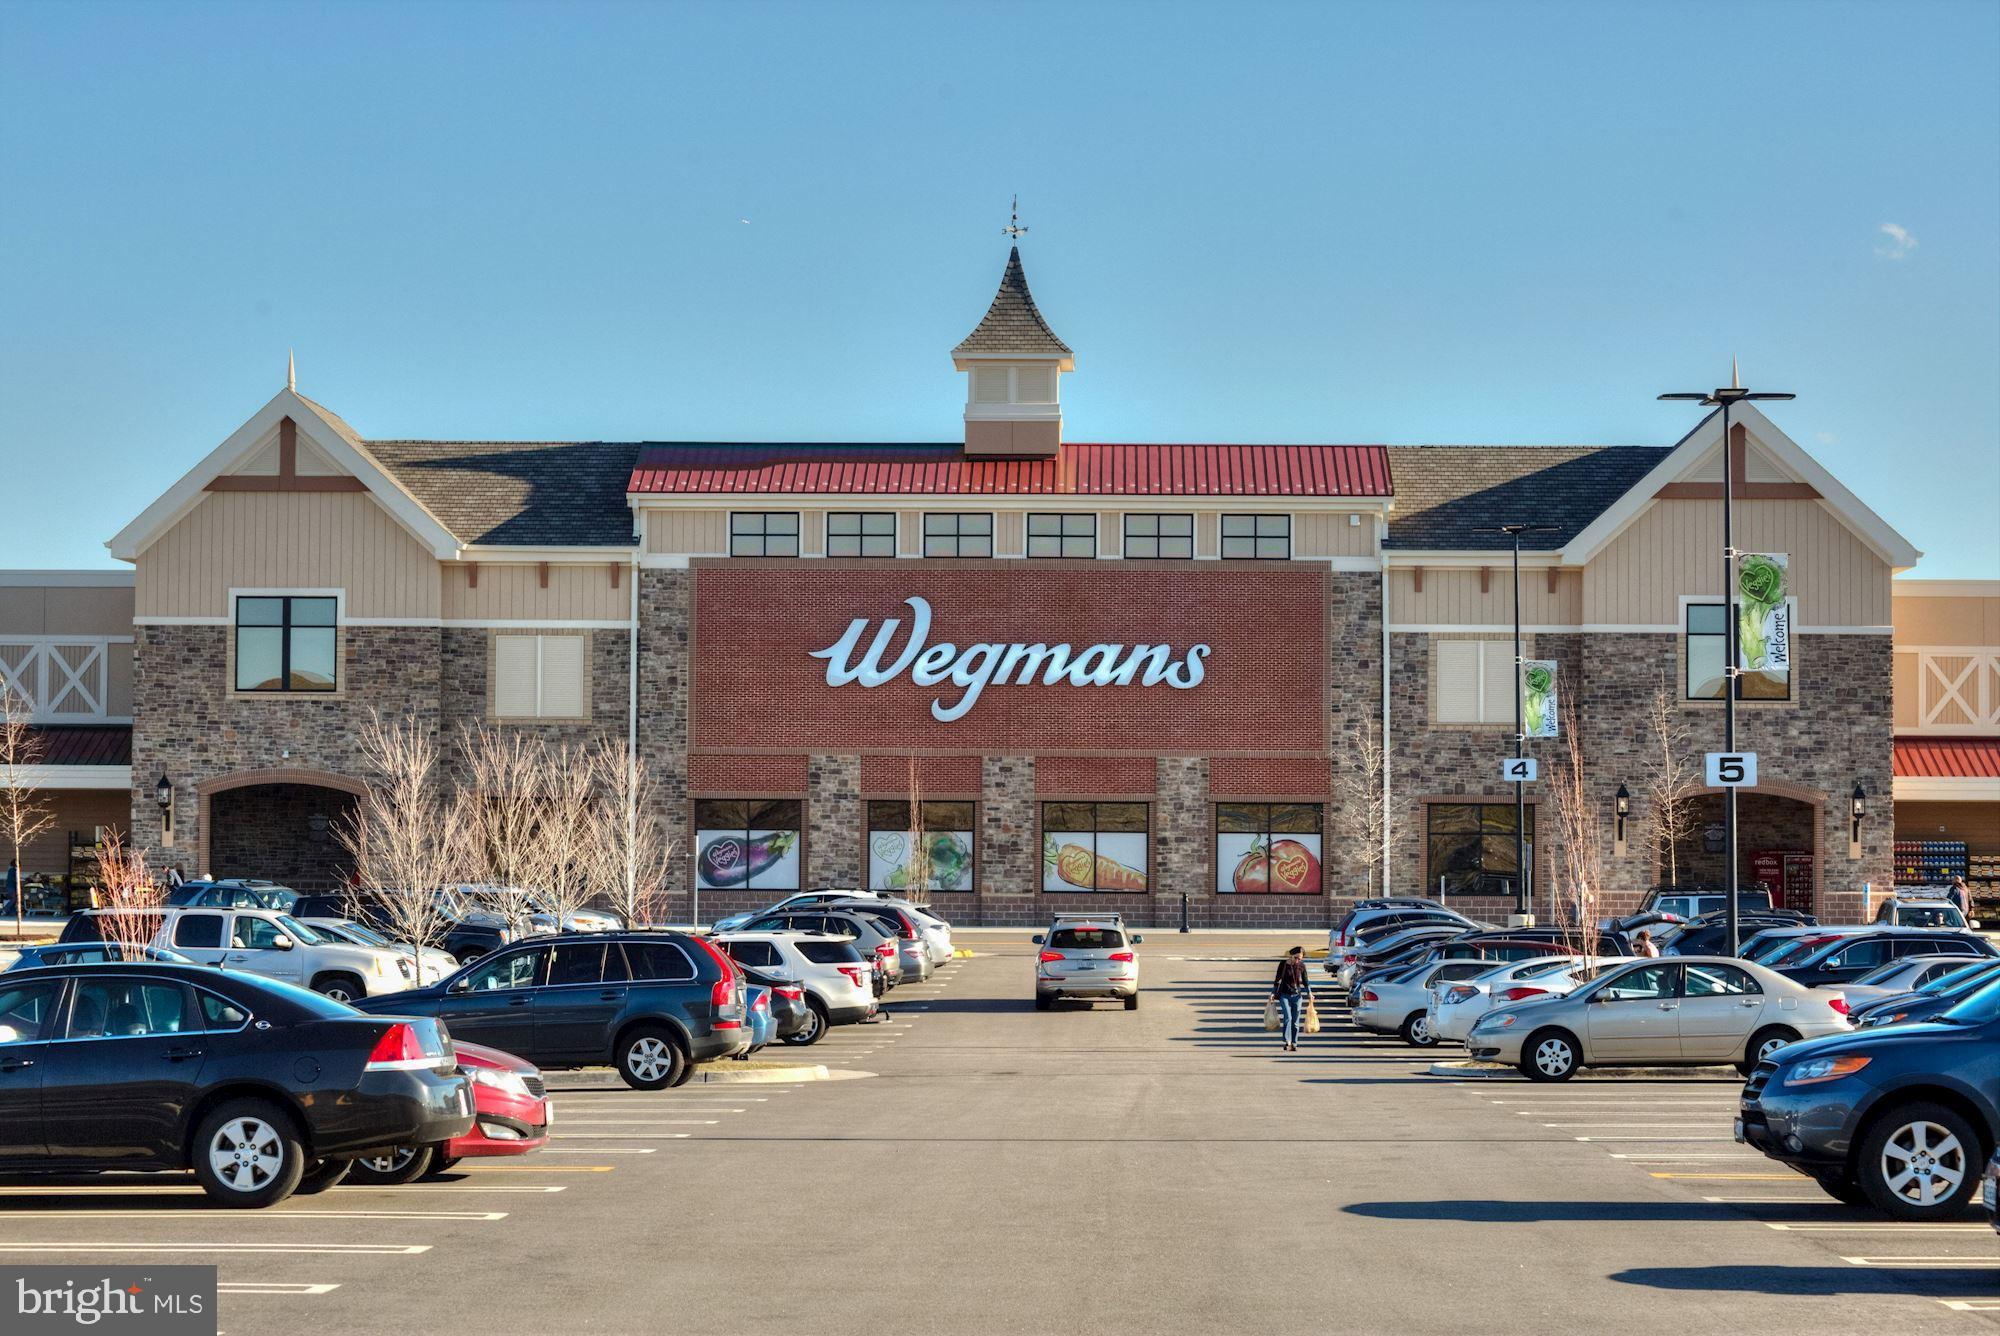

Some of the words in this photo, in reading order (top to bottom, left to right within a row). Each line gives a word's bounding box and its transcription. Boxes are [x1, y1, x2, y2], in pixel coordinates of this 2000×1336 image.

[1770, 613, 1786, 663] Welcome
[808, 596, 1211, 722] Wegmans
[1544, 699, 1556, 732] Welcome
[1511, 761, 1529, 778] 4
[1719, 757, 1744, 782] 5
[1755, 857, 1778, 866] redbox
